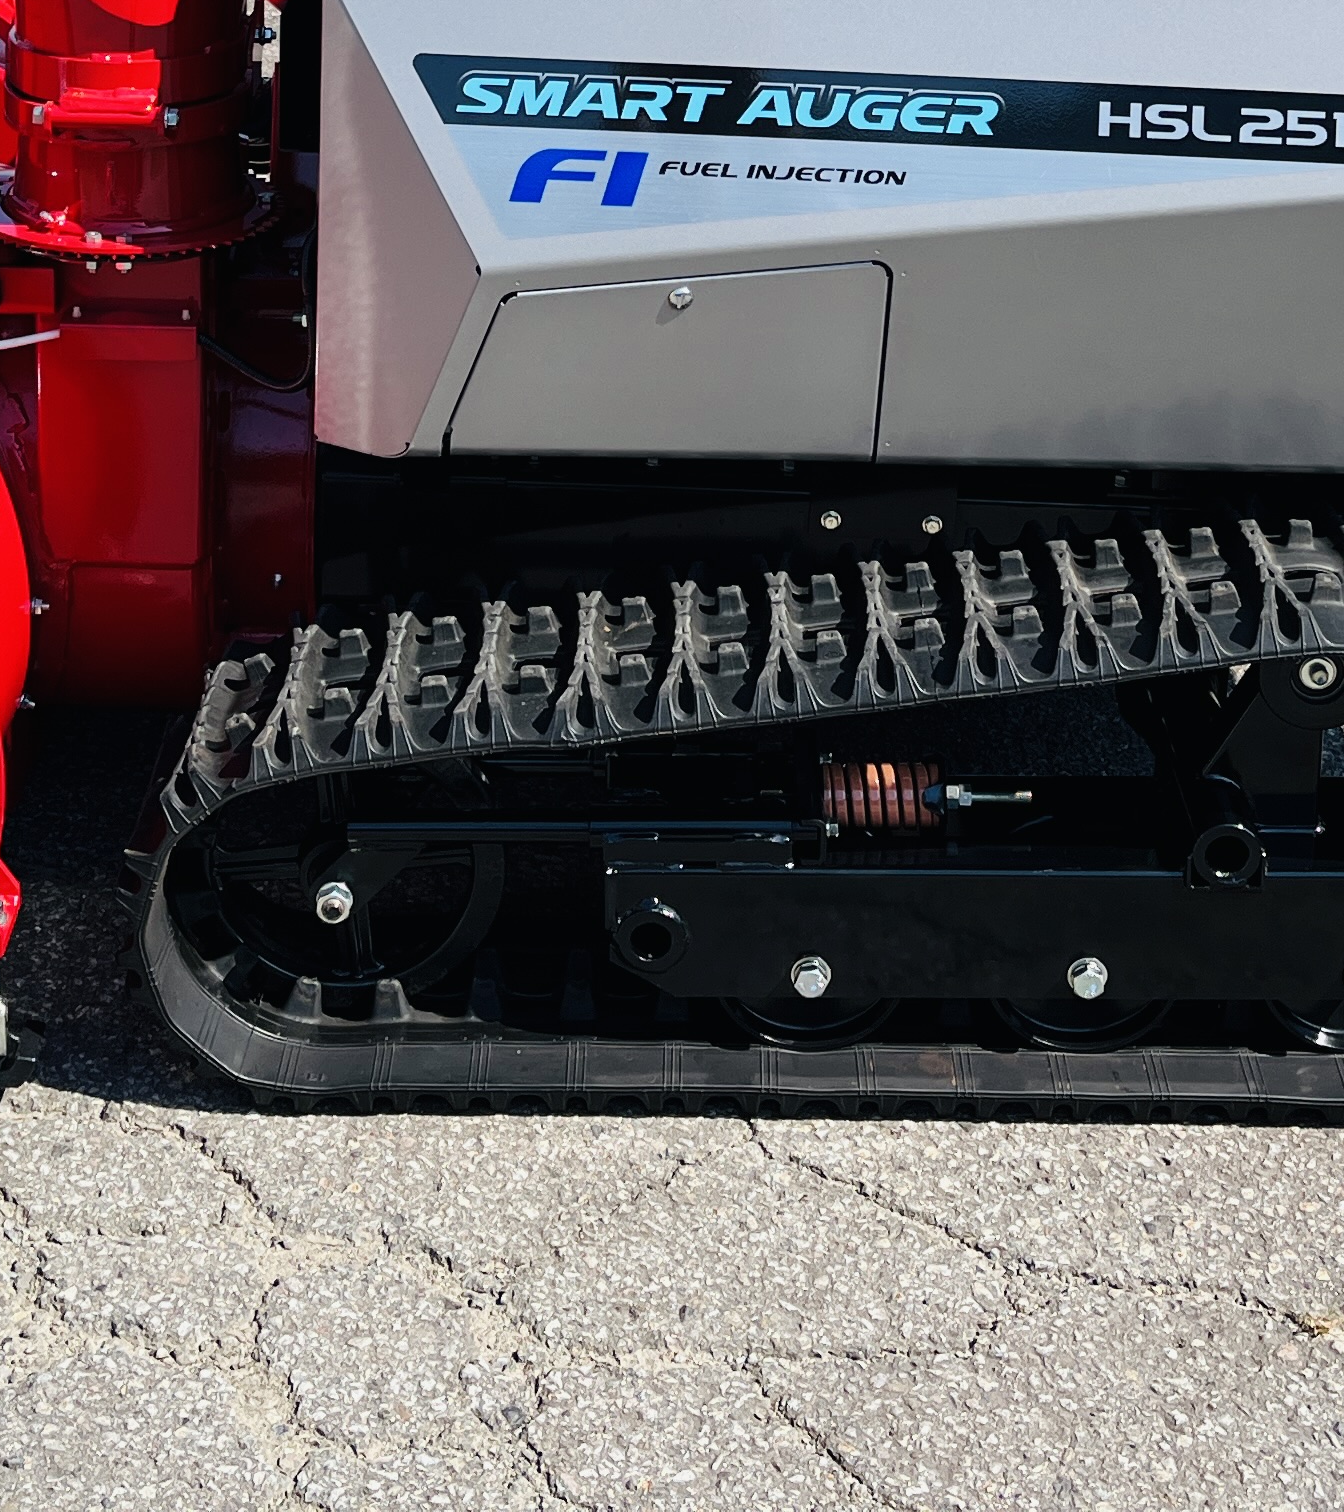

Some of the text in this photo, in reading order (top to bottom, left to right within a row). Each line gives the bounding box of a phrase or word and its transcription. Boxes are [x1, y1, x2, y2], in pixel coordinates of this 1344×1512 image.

[455, 71, 1005, 137] SMART AUGER
[508, 148, 649, 208] FI
[657, 159, 908, 187] FUEL INJECTION
